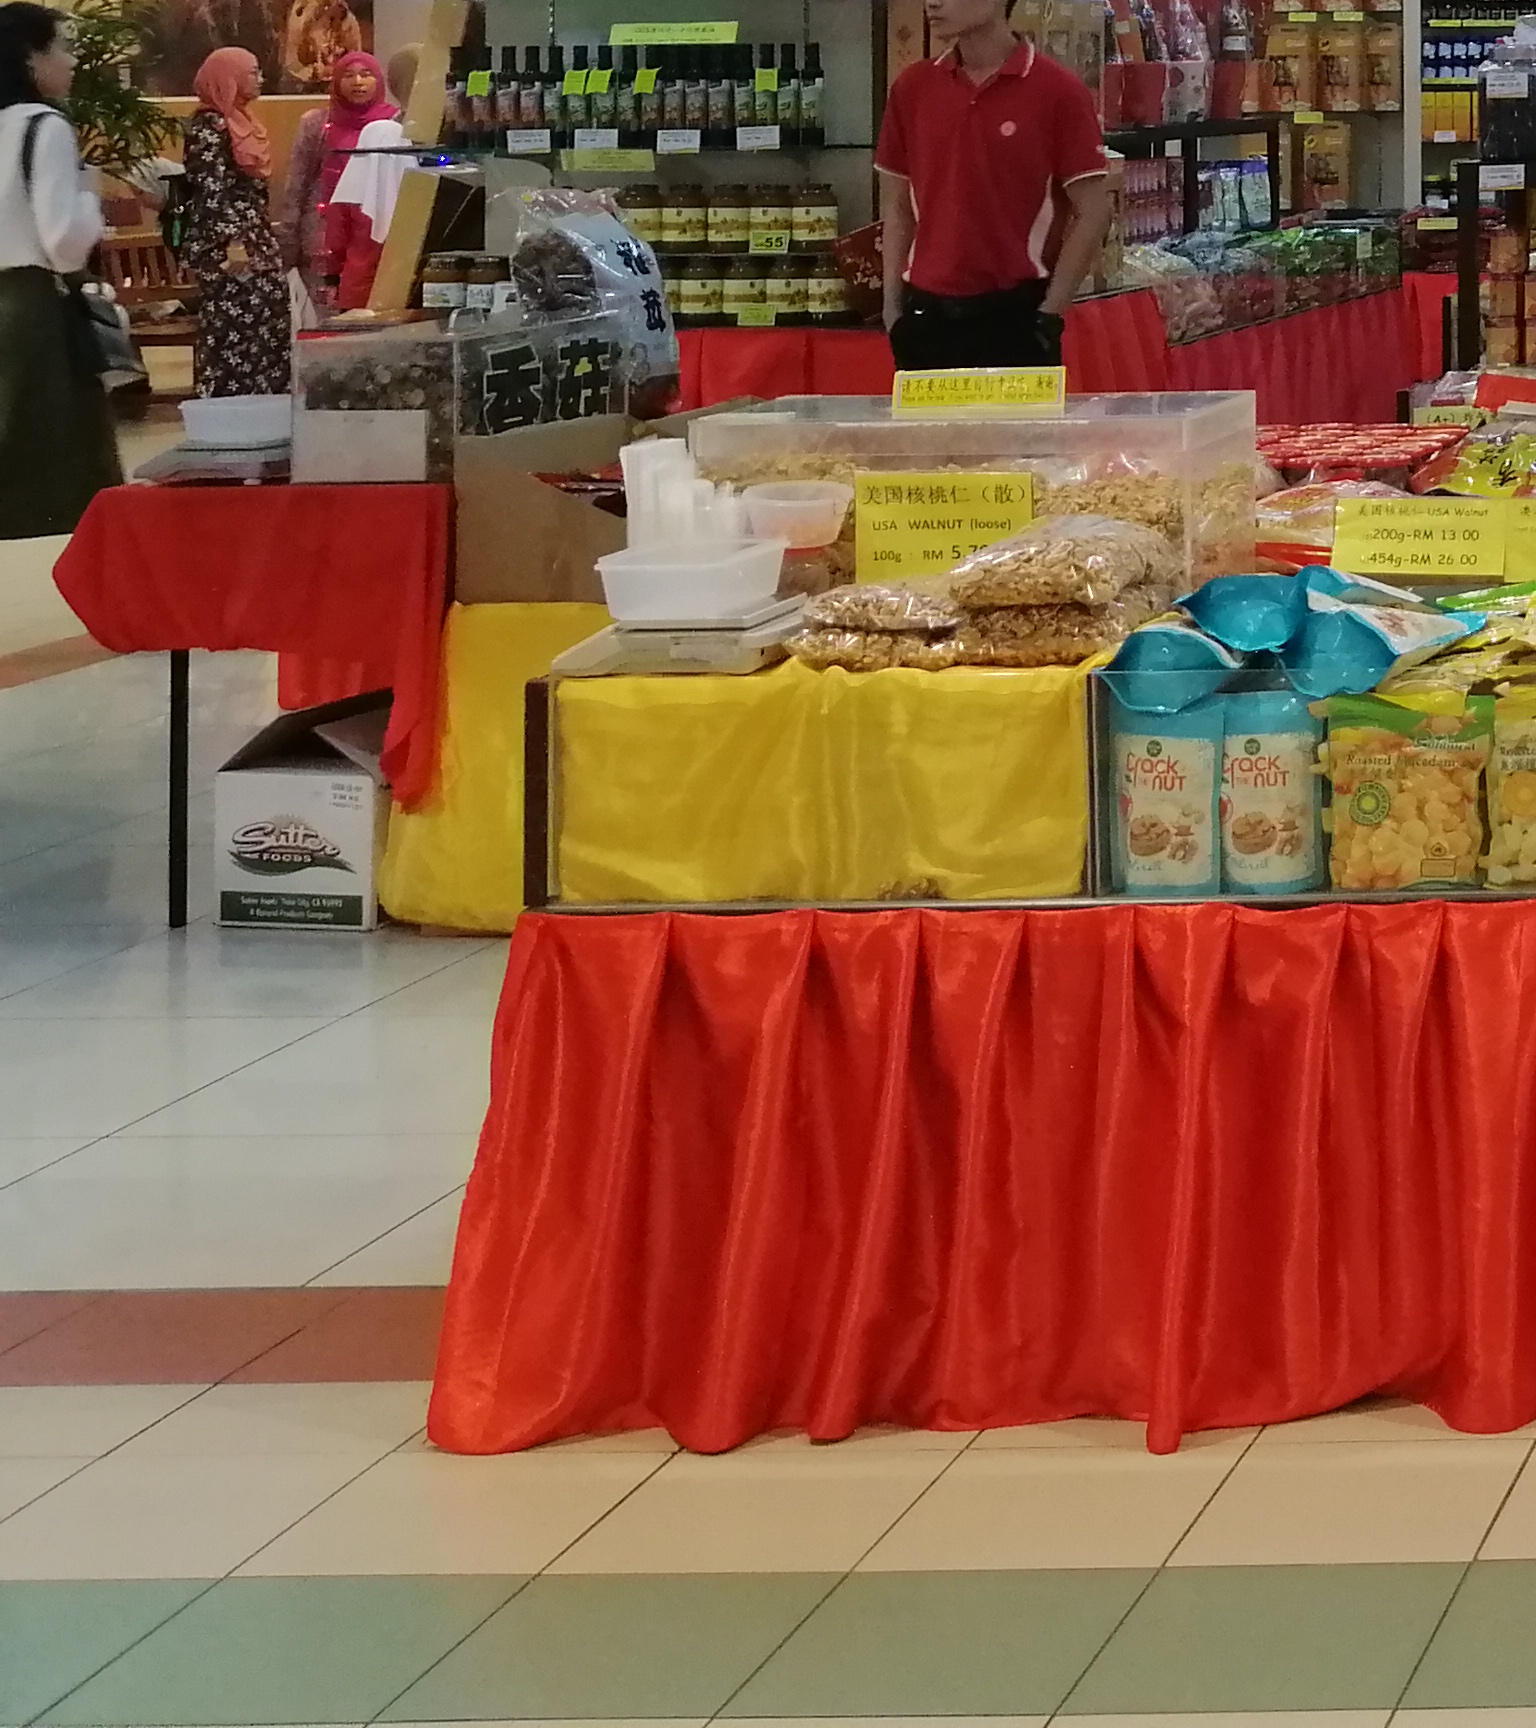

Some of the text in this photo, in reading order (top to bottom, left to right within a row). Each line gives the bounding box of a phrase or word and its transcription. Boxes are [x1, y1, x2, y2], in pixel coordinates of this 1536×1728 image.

[1453, 506, 1490, 518] Walnut
[872, 518, 1012, 532] USA WALNUT (loose)
[872, 550, 902, 564] 100g
[922, 550, 944, 561] RM
[1346, 754, 1392, 766] Roasted
[1126, 751, 1179, 788] Crack
[1222, 751, 1282, 789] Crack
[262, 852, 313, 863] FOODS
